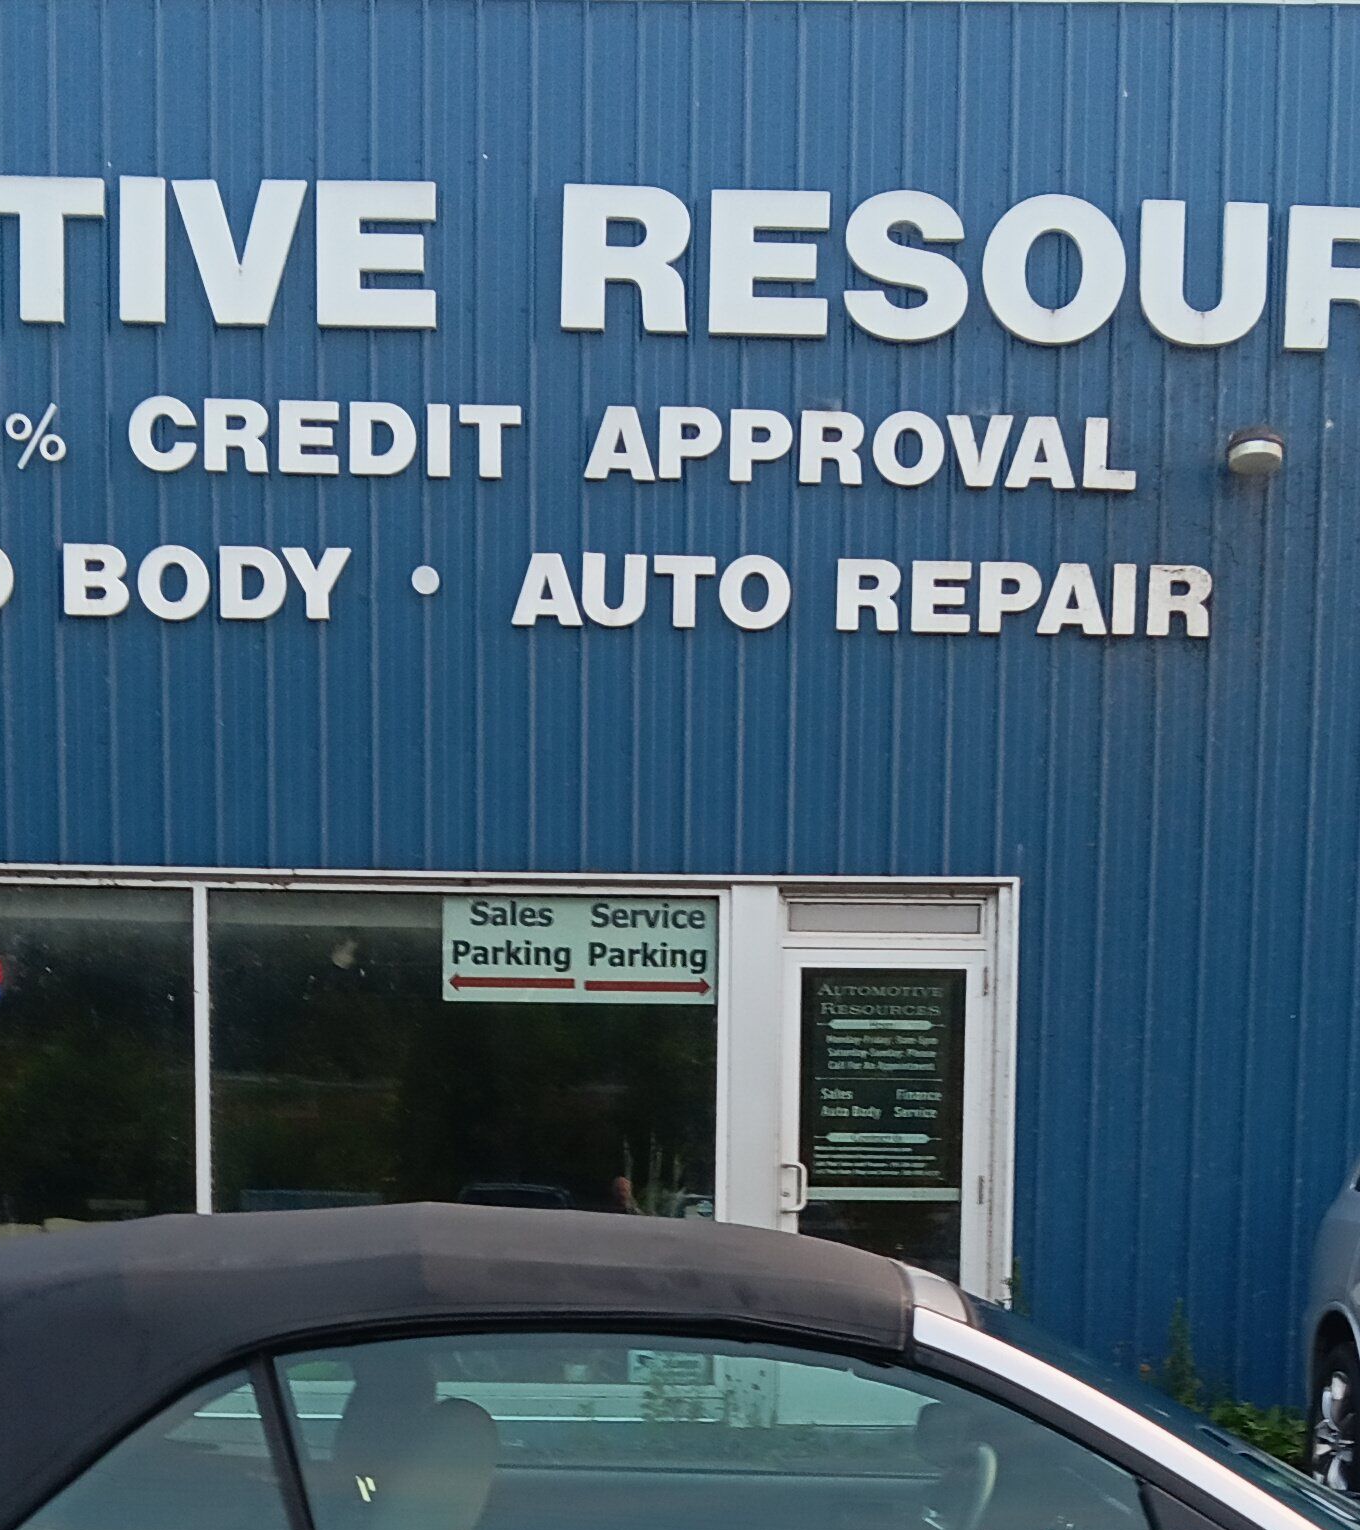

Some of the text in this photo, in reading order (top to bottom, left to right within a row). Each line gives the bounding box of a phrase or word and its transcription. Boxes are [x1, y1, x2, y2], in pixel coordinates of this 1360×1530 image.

[128, 395, 522, 480] CREDIT
[583, 405, 1137, 491] APPROVAL
[63, 543, 352, 620] BODY
[511, 551, 791, 631] AUTO
[835, 558, 1213, 638] REPAIR
[469, 901, 554, 928] Sales
[590, 902, 706, 930] Service
[452, 940, 571, 972] Parking
[588, 942, 707, 974] Parking
[817, 983, 945, 998] AUTOMOTIVE
[820, 1002, 942, 1016] RESOURCES
